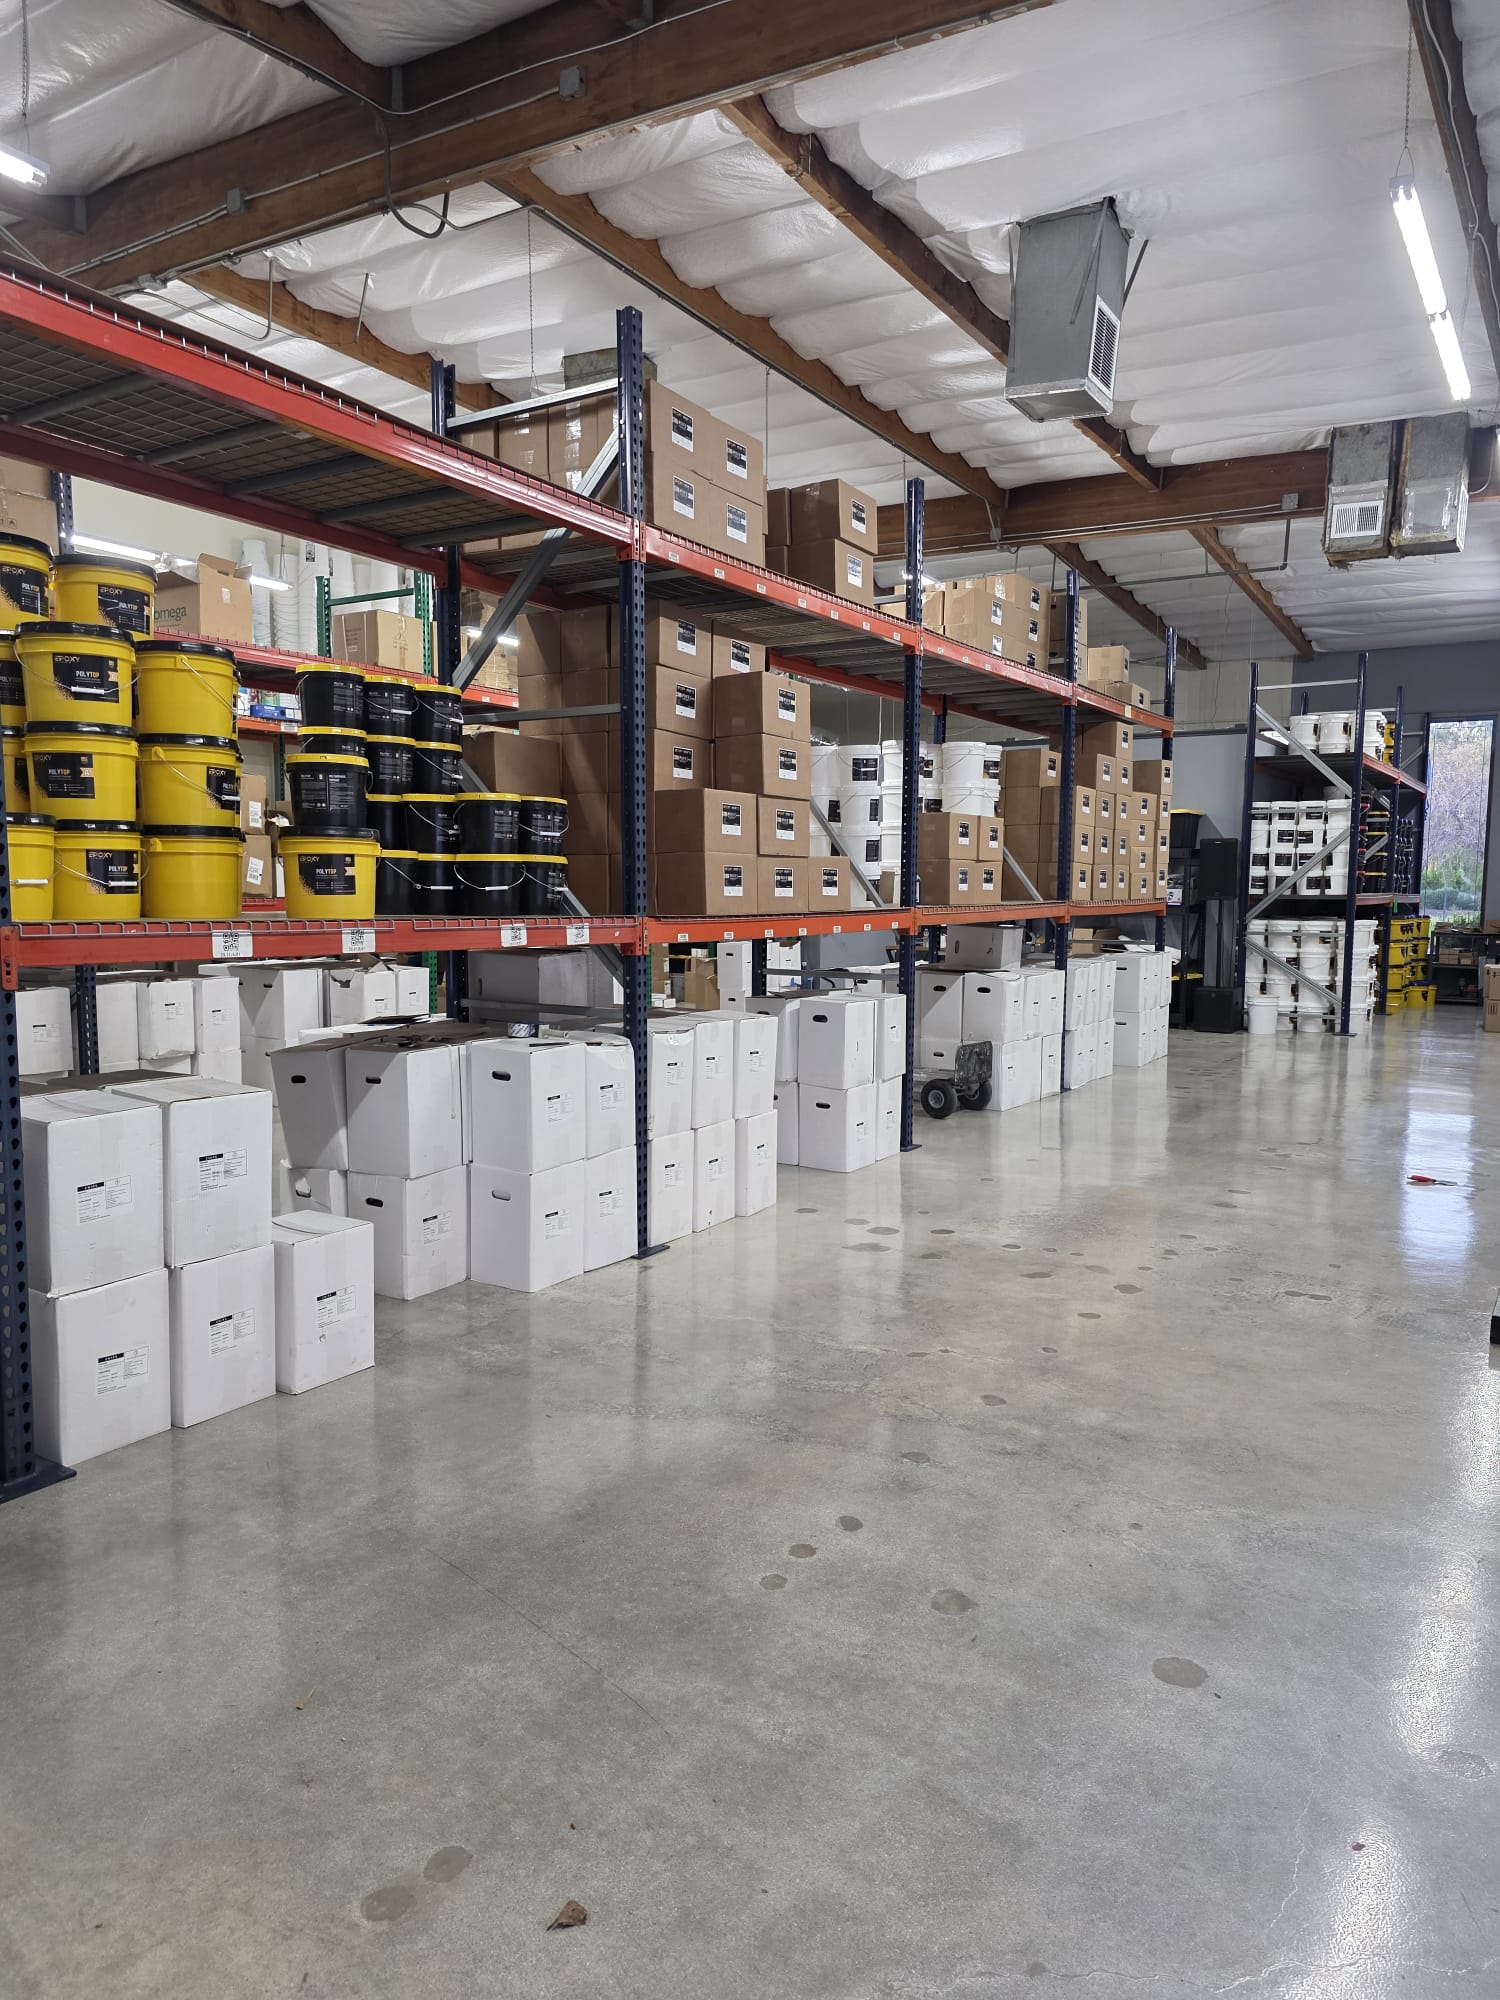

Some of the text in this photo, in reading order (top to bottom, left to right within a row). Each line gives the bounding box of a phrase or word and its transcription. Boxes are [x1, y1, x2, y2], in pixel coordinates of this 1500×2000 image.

[2, 565, 26, 576] EPOXY
[99, 586, 123, 596] EPOXY
[55, 655, 80, 664] EPOXY
[75, 670, 100, 679] POLYTOP
[48, 768, 71, 776] POLYTOP
[88, 851, 113, 860] EPOXY
[299, 855, 320, 863] EPOXY
[108, 865, 128, 873] POLYTOP
